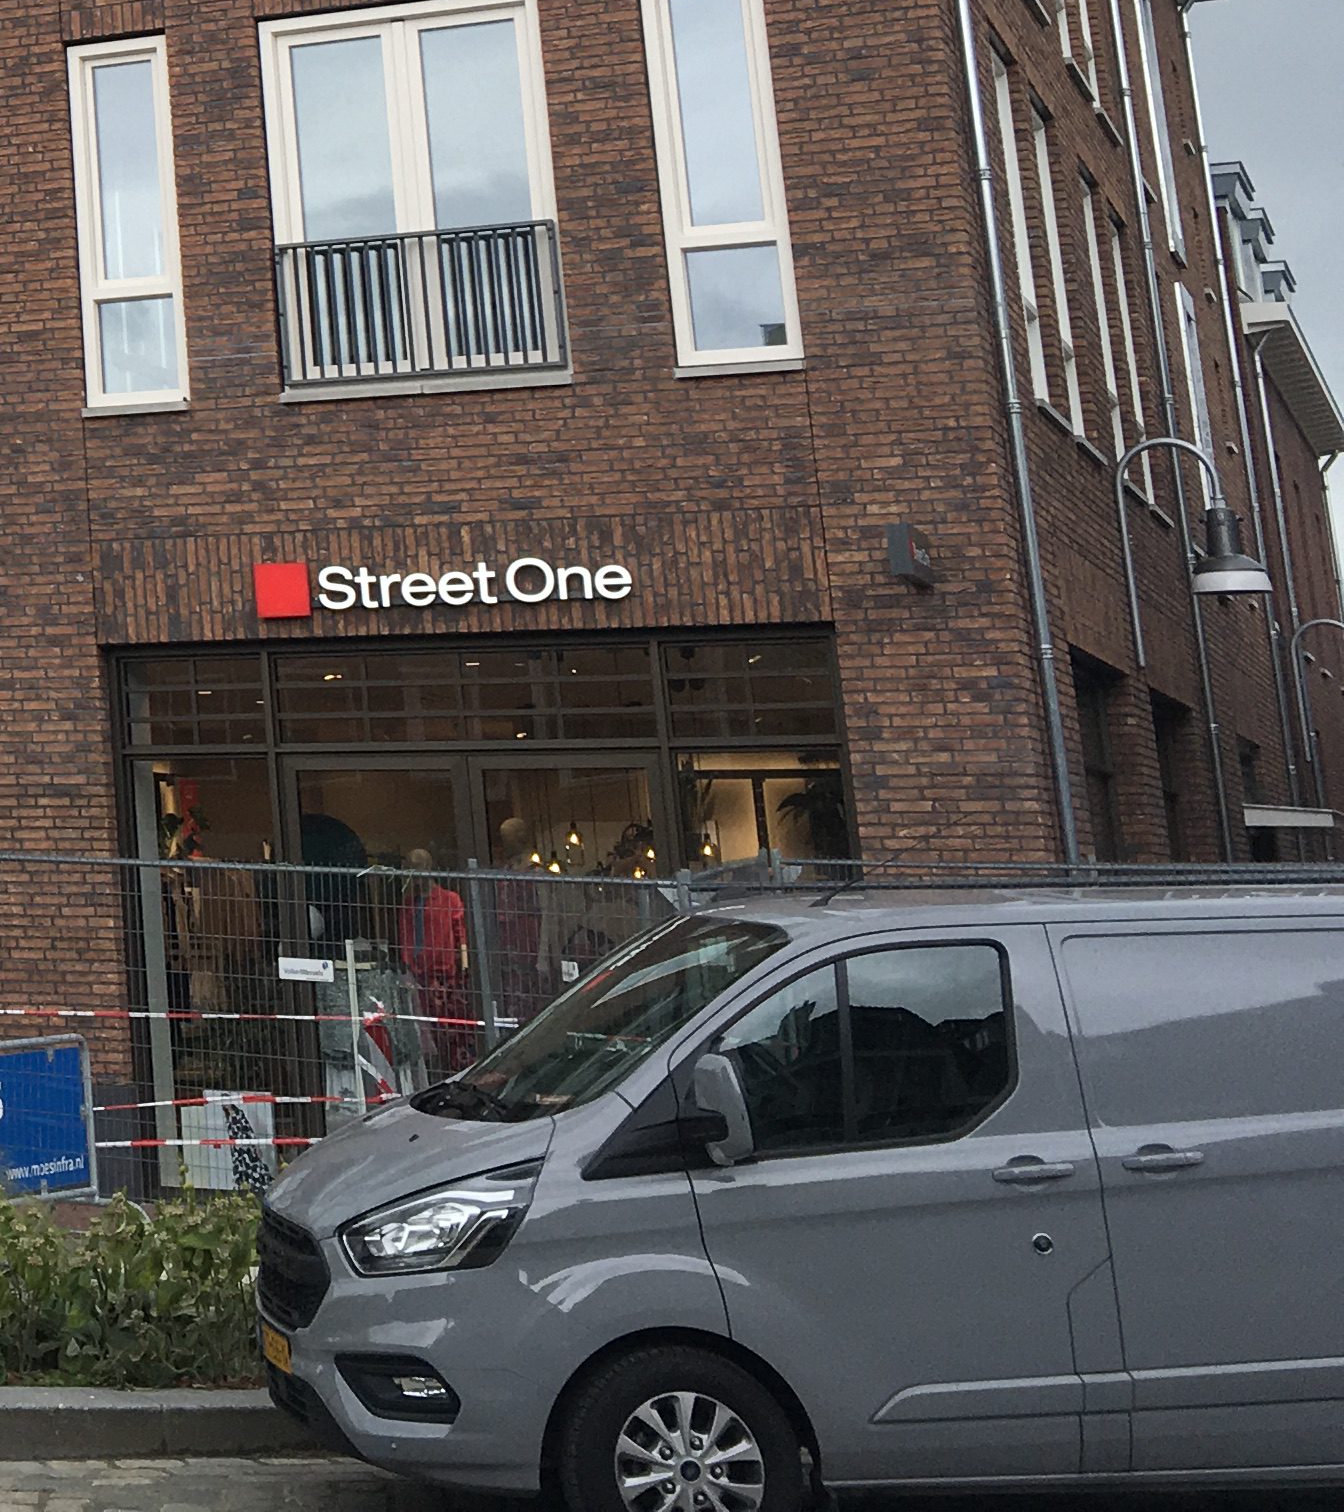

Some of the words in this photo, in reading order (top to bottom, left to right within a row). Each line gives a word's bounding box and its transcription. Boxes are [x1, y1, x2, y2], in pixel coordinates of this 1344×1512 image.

[318, 562, 498, 610] Street
[506, 557, 633, 603] One
[6, 1155, 85, 1180] www.moesinfra.nl
